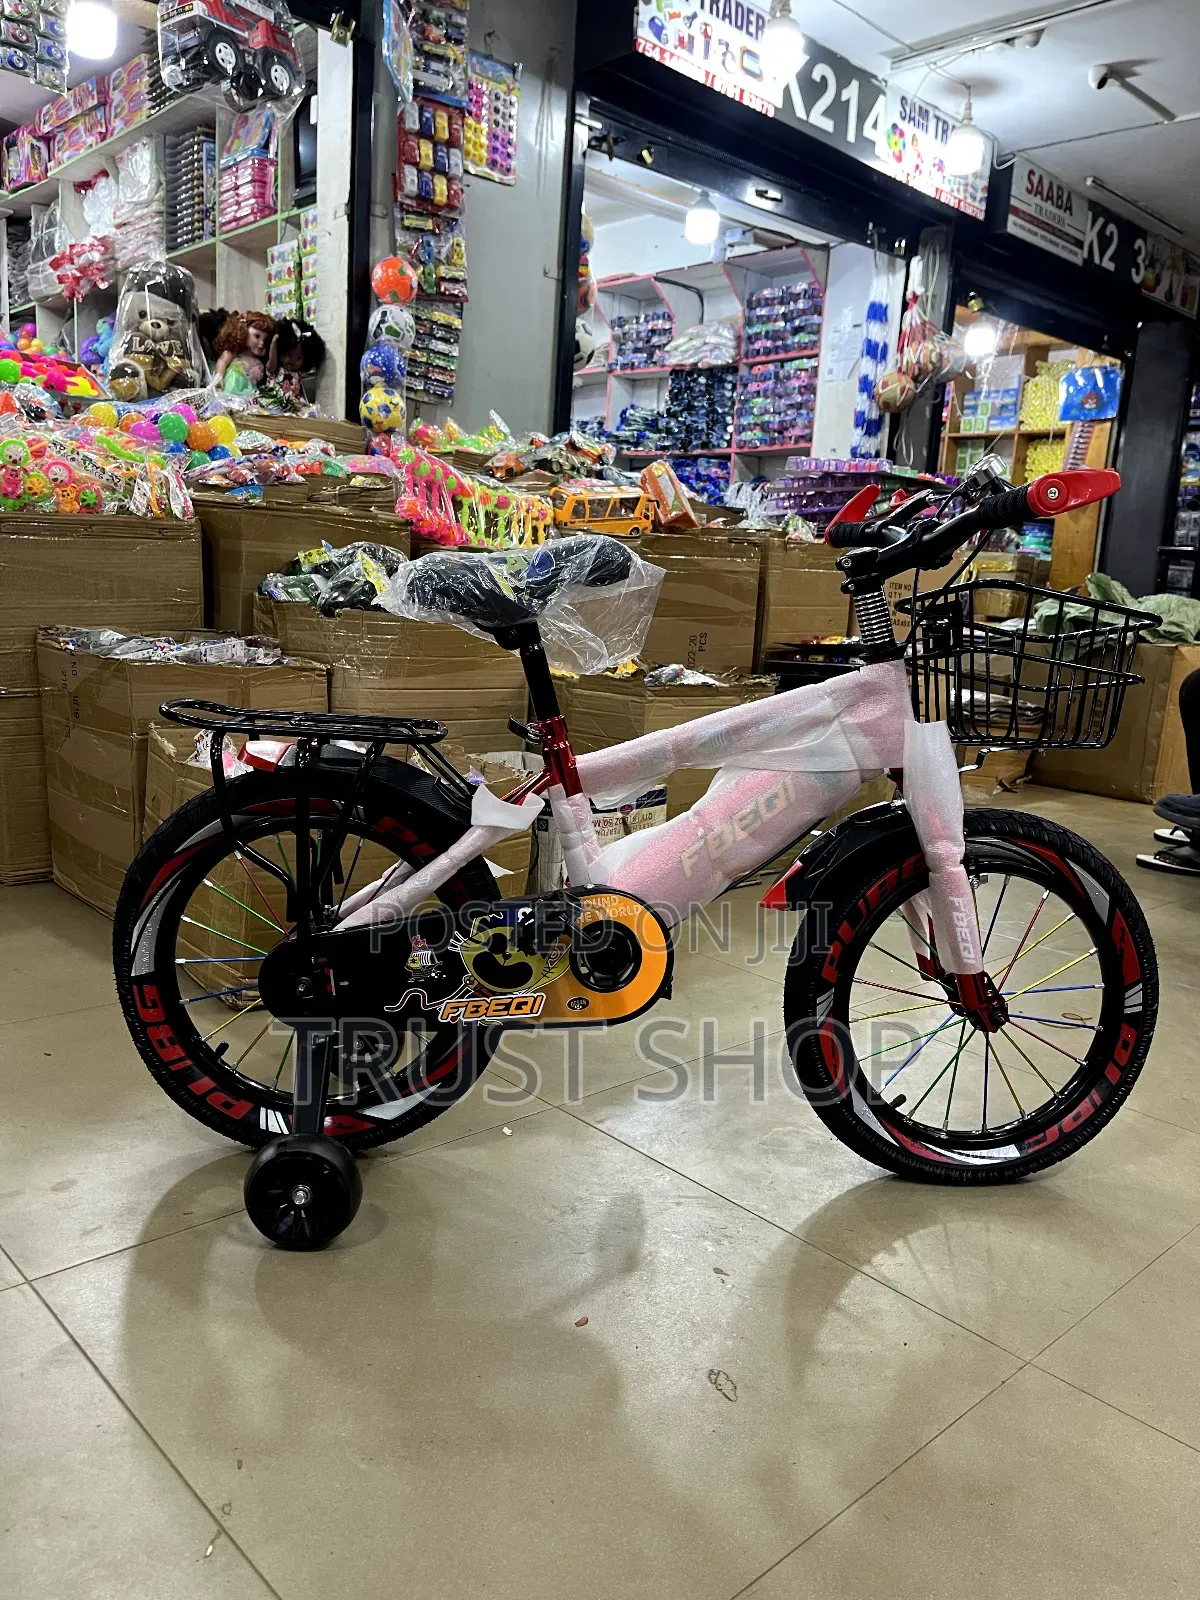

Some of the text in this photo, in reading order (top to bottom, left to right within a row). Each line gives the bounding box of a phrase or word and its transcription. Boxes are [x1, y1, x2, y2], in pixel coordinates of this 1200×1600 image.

[700, 0, 766, 41] RADER
[1026, 168, 1073, 216] SAABA
[1084, 210, 1118, 272] K2
[698, 632, 708, 652] PCS
[680, 778, 797, 878] FBEQI
[575, 904, 642, 923] HE WORLD
[582, 895, 620, 910] OUND
[948, 896, 977, 964] FBEQI
[438, 992, 547, 1023] FBEQI
